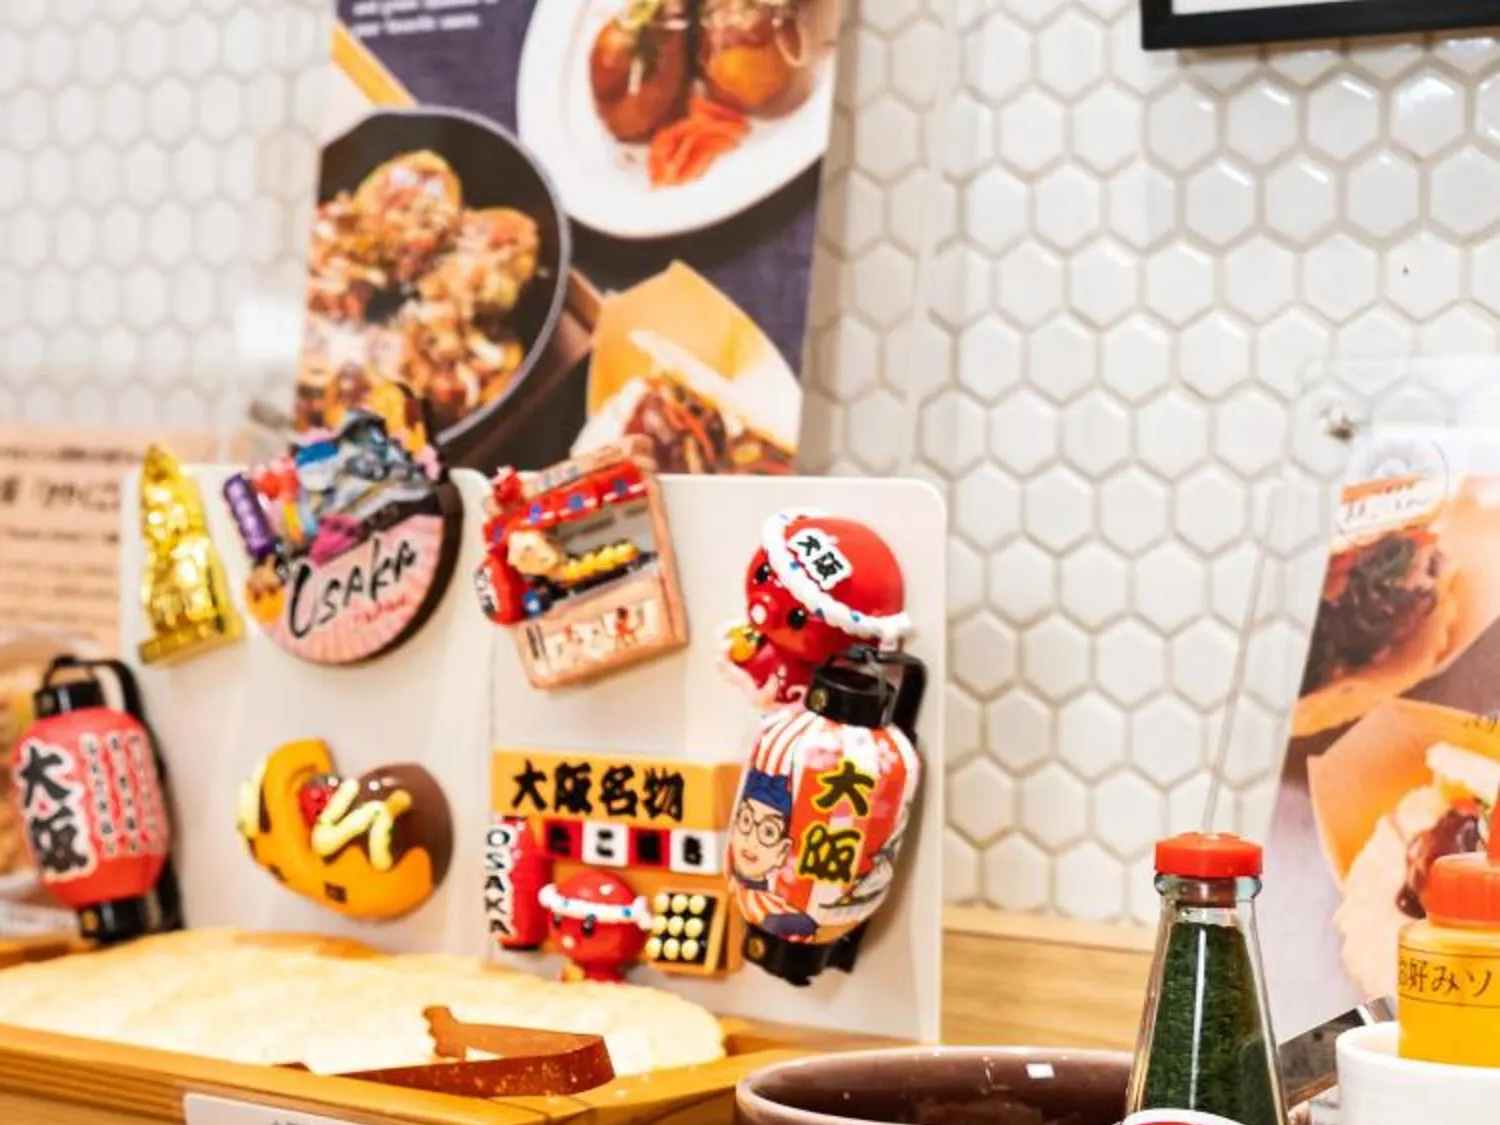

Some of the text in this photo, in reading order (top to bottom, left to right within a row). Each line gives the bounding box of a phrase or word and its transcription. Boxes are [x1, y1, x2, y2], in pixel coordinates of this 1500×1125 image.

[795, 533, 844, 582] 大阪
[19, 744, 89, 874] 大阪
[511, 759, 685, 823] 大阪名物
[799, 760, 875, 884] 大阪
[484, 828, 513, 936] OSAKA
